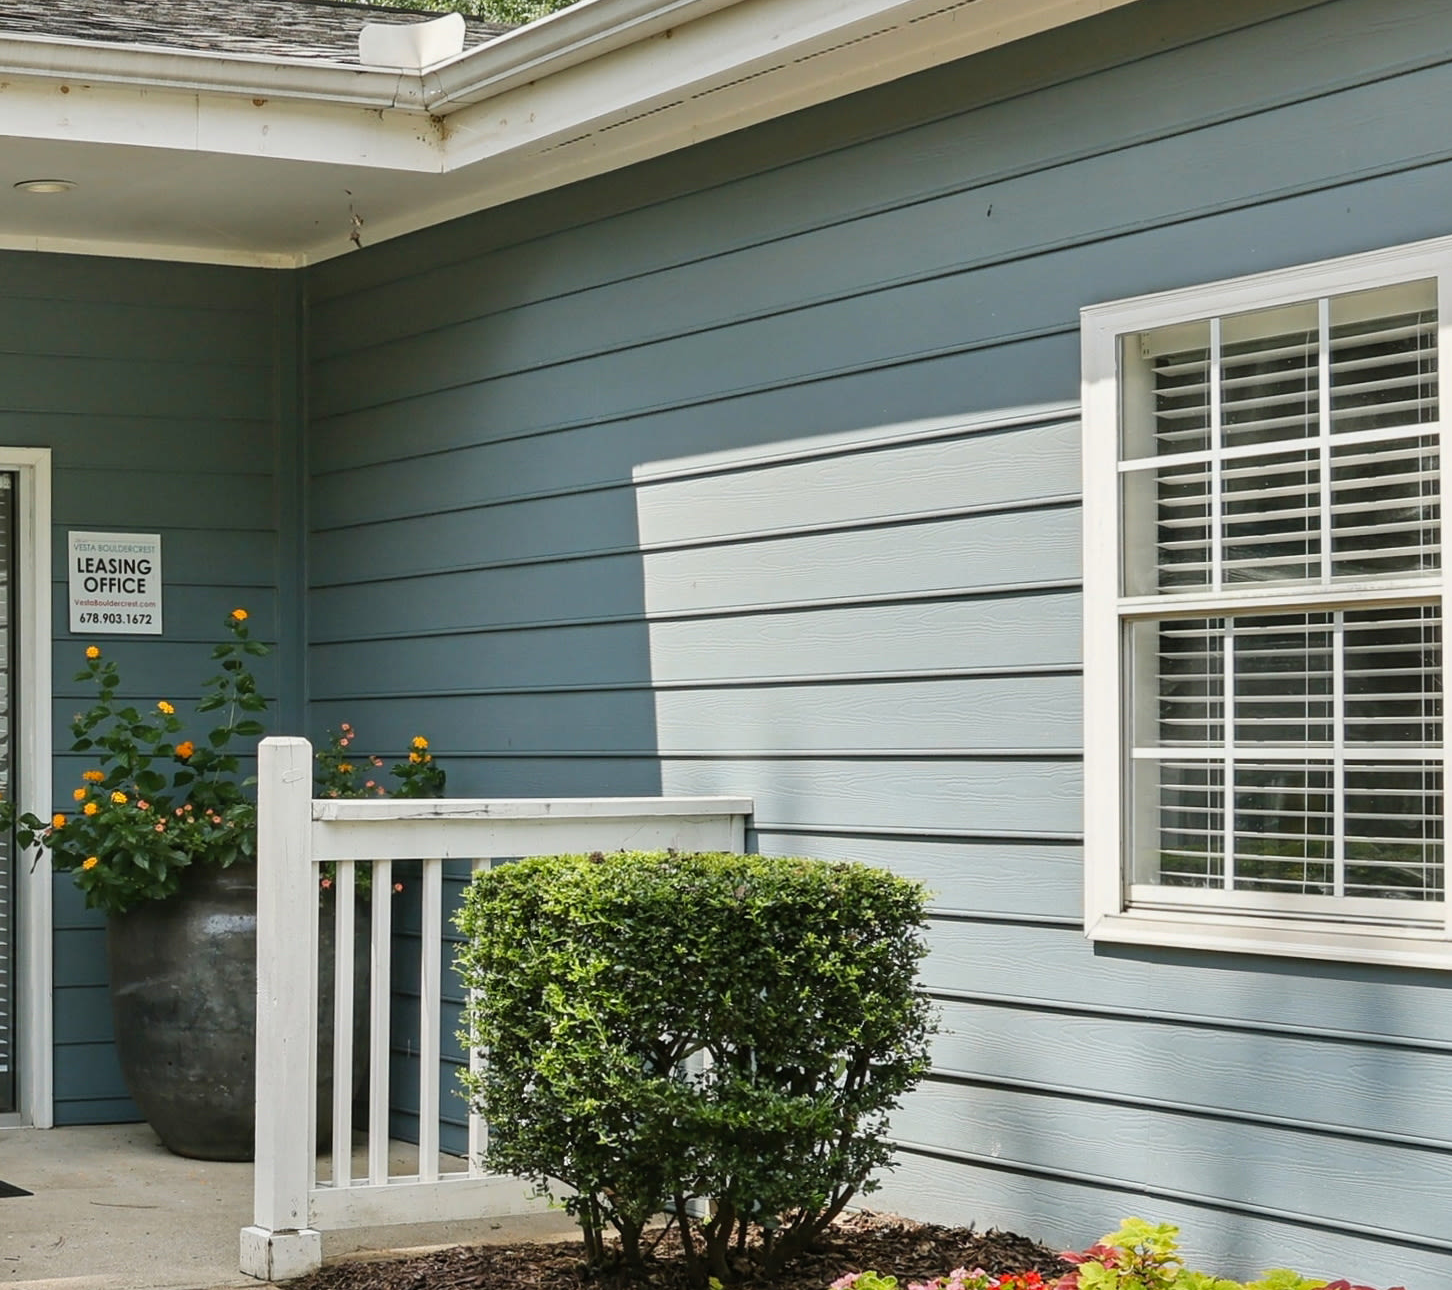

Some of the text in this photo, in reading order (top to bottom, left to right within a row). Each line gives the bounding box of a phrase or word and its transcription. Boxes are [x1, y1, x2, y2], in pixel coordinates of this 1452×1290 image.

[74, 543, 155, 554] VESTA BOULDERCREST
[77, 557, 152, 575] LEASING
[83, 576, 146, 593] OFFICE
[79, 613, 152, 624] 678.903.1672
